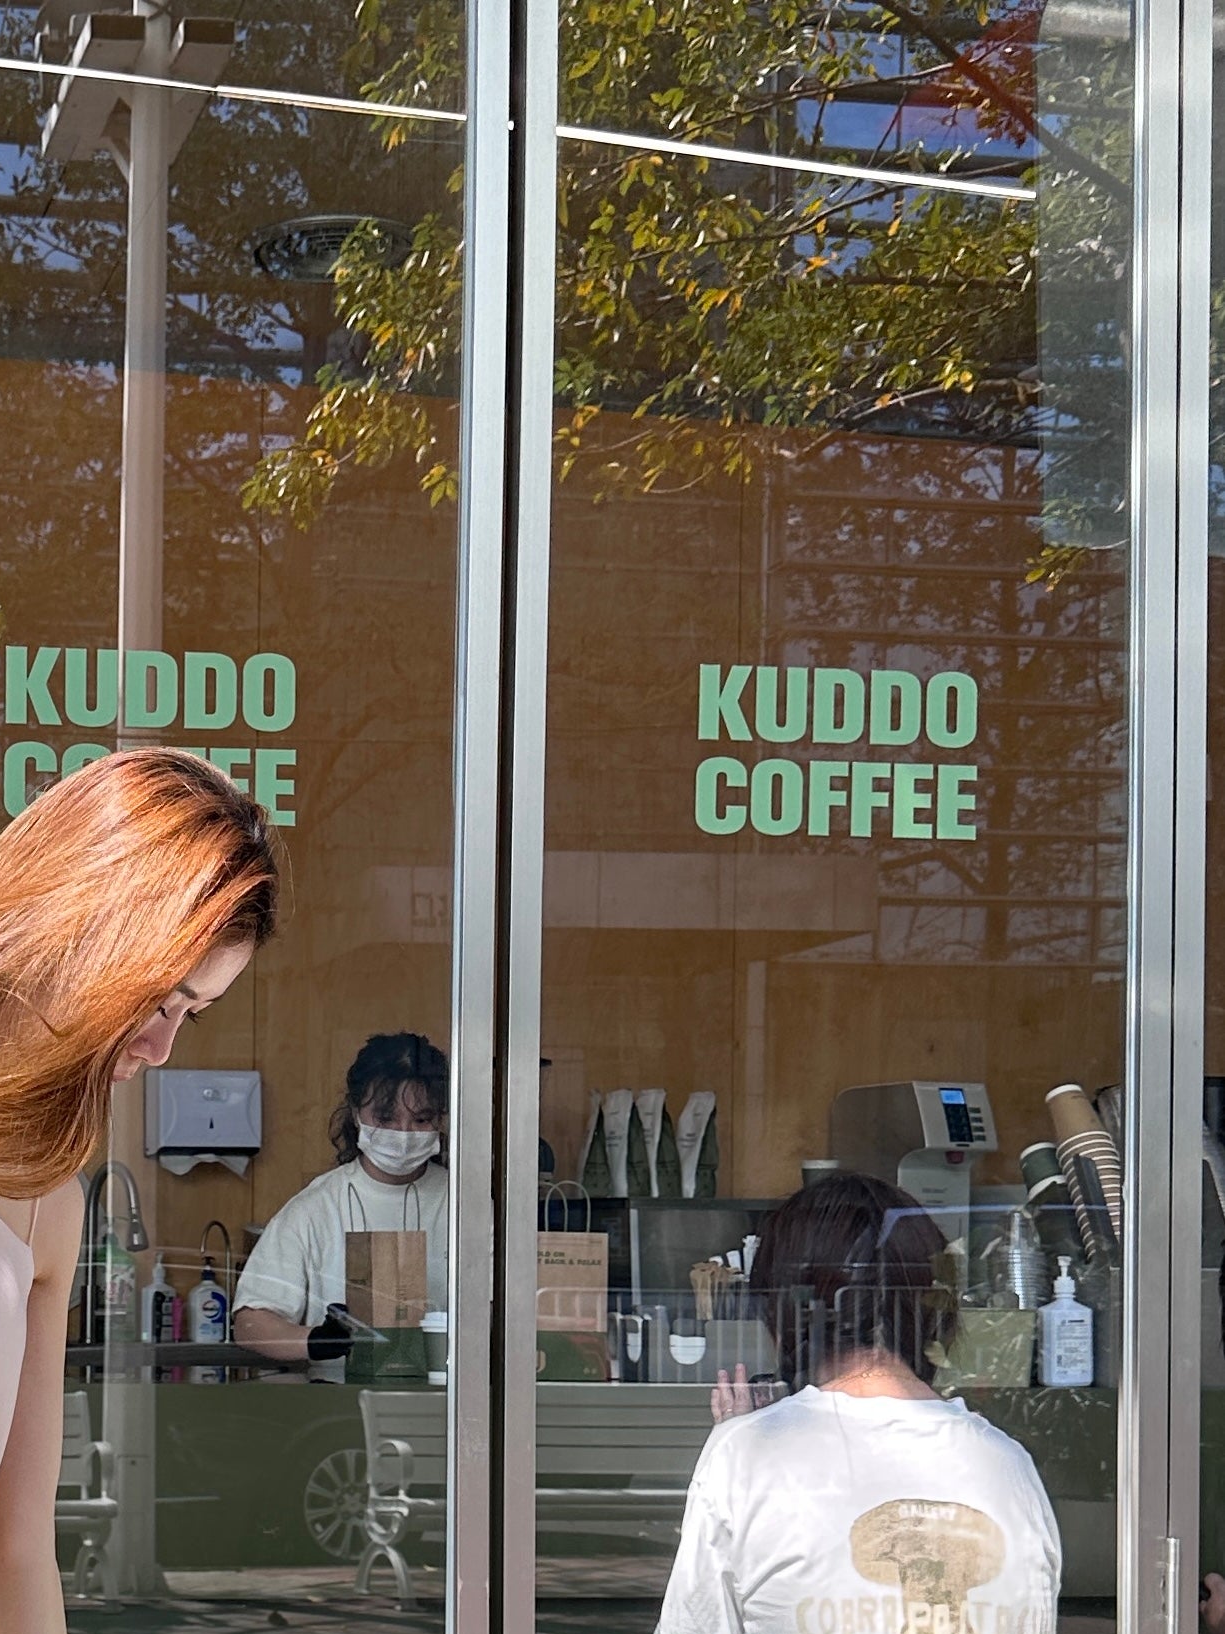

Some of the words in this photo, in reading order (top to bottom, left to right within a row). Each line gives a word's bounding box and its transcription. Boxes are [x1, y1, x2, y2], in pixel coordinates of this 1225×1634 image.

[6, 646, 296, 732] KUDDO
[699, 664, 979, 748] KUDDO
[695, 757, 979, 841] COFFEE
